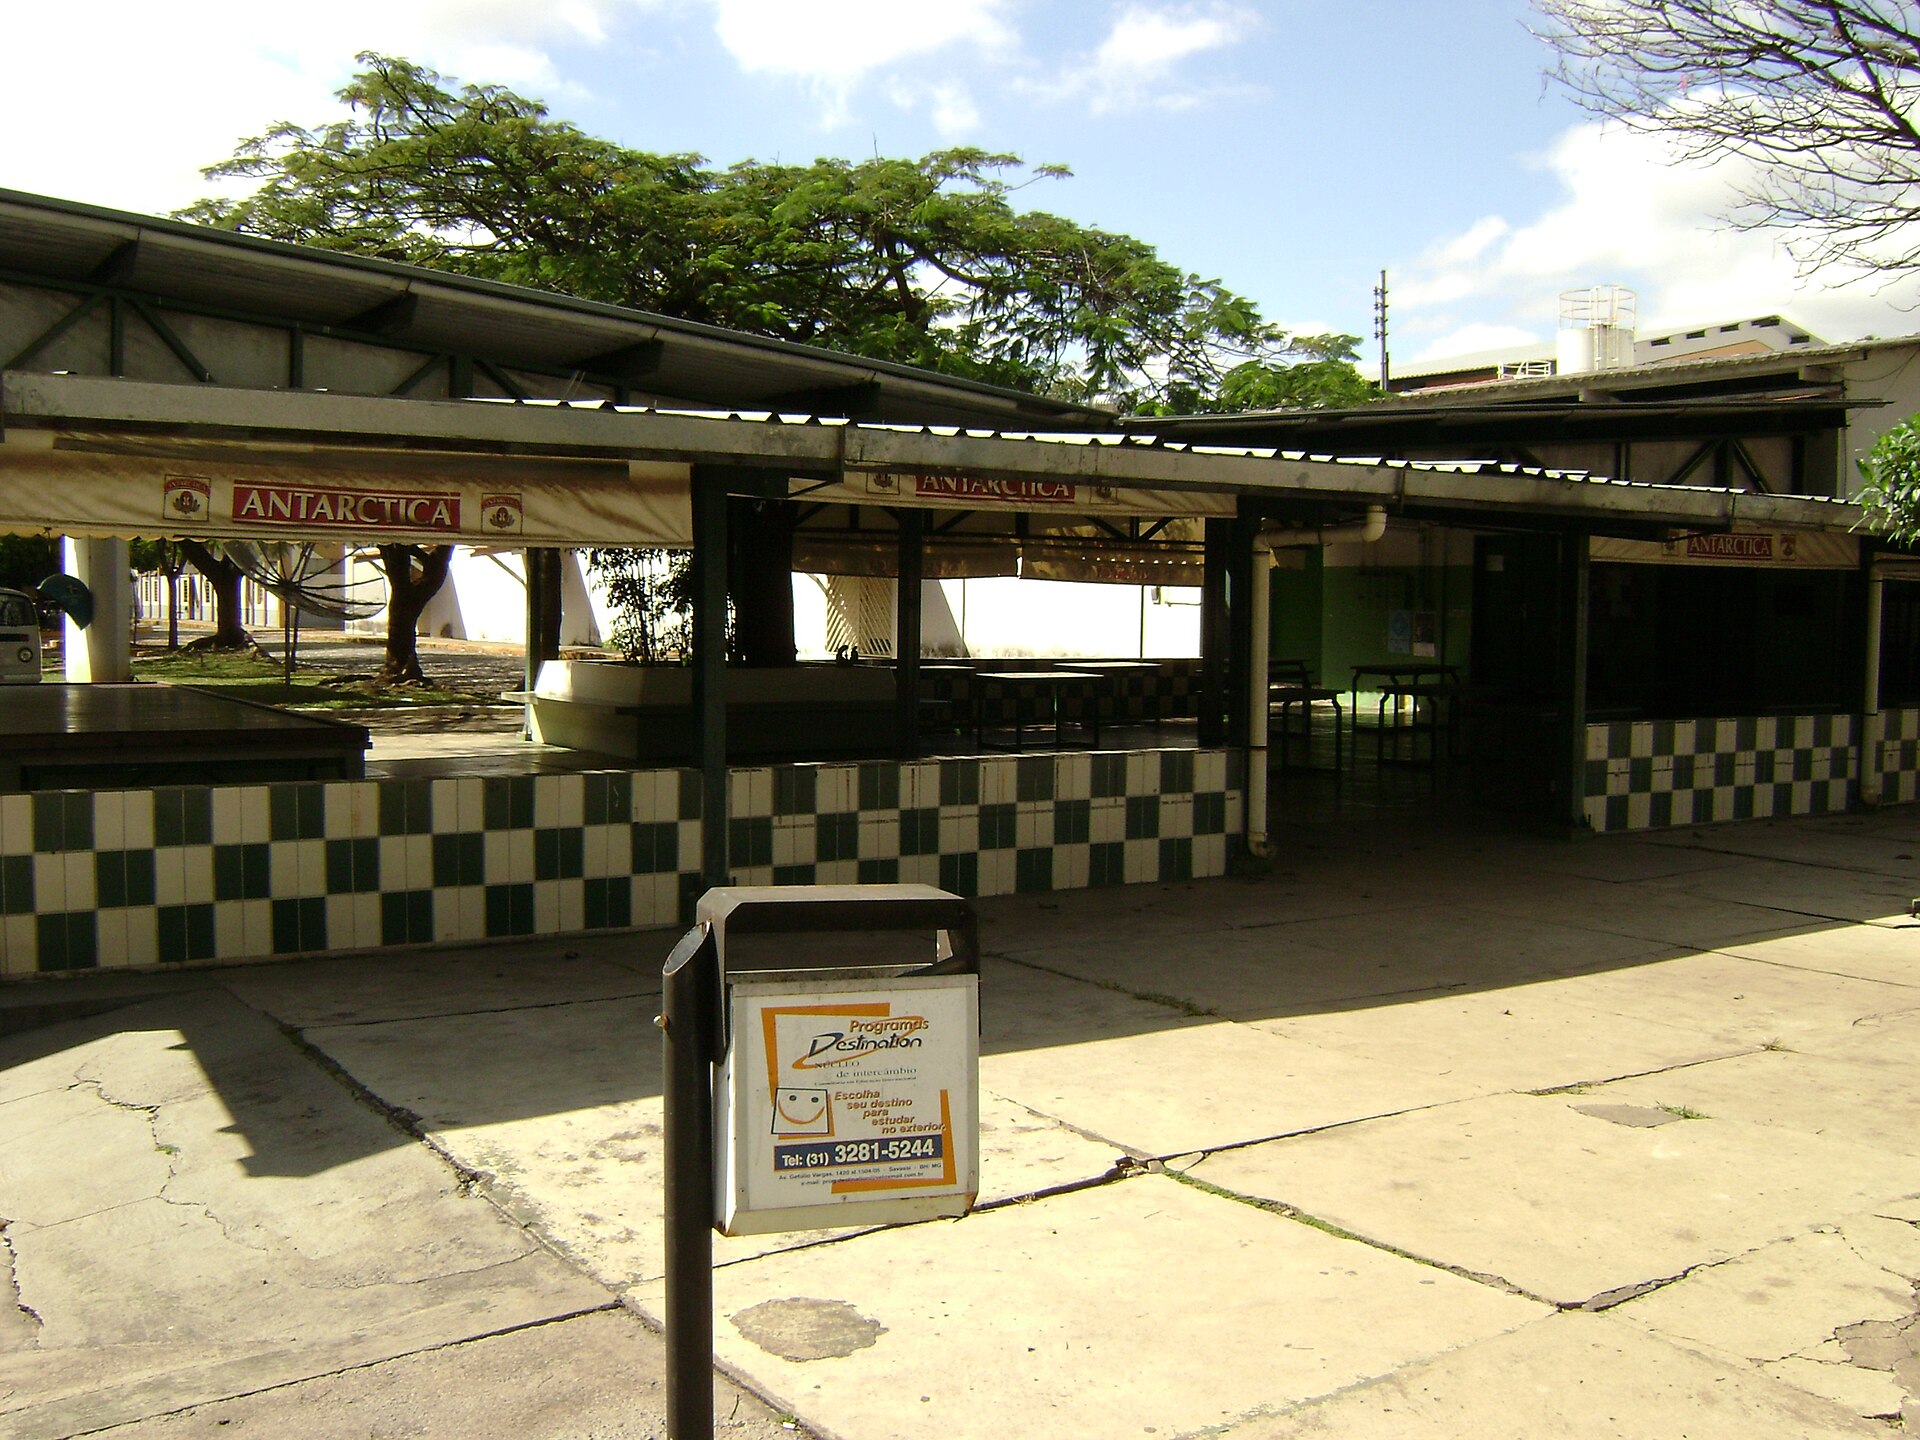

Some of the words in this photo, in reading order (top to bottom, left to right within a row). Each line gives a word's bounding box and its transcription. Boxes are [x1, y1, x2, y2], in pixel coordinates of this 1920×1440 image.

[241, 489, 452, 526] ANTARCTICA
[1690, 536, 1770, 555] ANTARCTICA
[849, 1019, 929, 1034] Programas
[808, 1032, 922, 1058] Destination
[836, 1070, 849, 1078] de
[834, 1089, 880, 1100] Escolha
[847, 1101, 867, 1110] seu
[870, 1098, 913, 1109] destino
[862, 1108, 889, 1119] para
[871, 1115, 915, 1126] estudar
[881, 1125, 897, 1134] no
[782, 1153, 803, 1167] Tel:
[806, 1151, 829, 1167] (31)
[834, 1138, 934, 1163] 3281-5244
